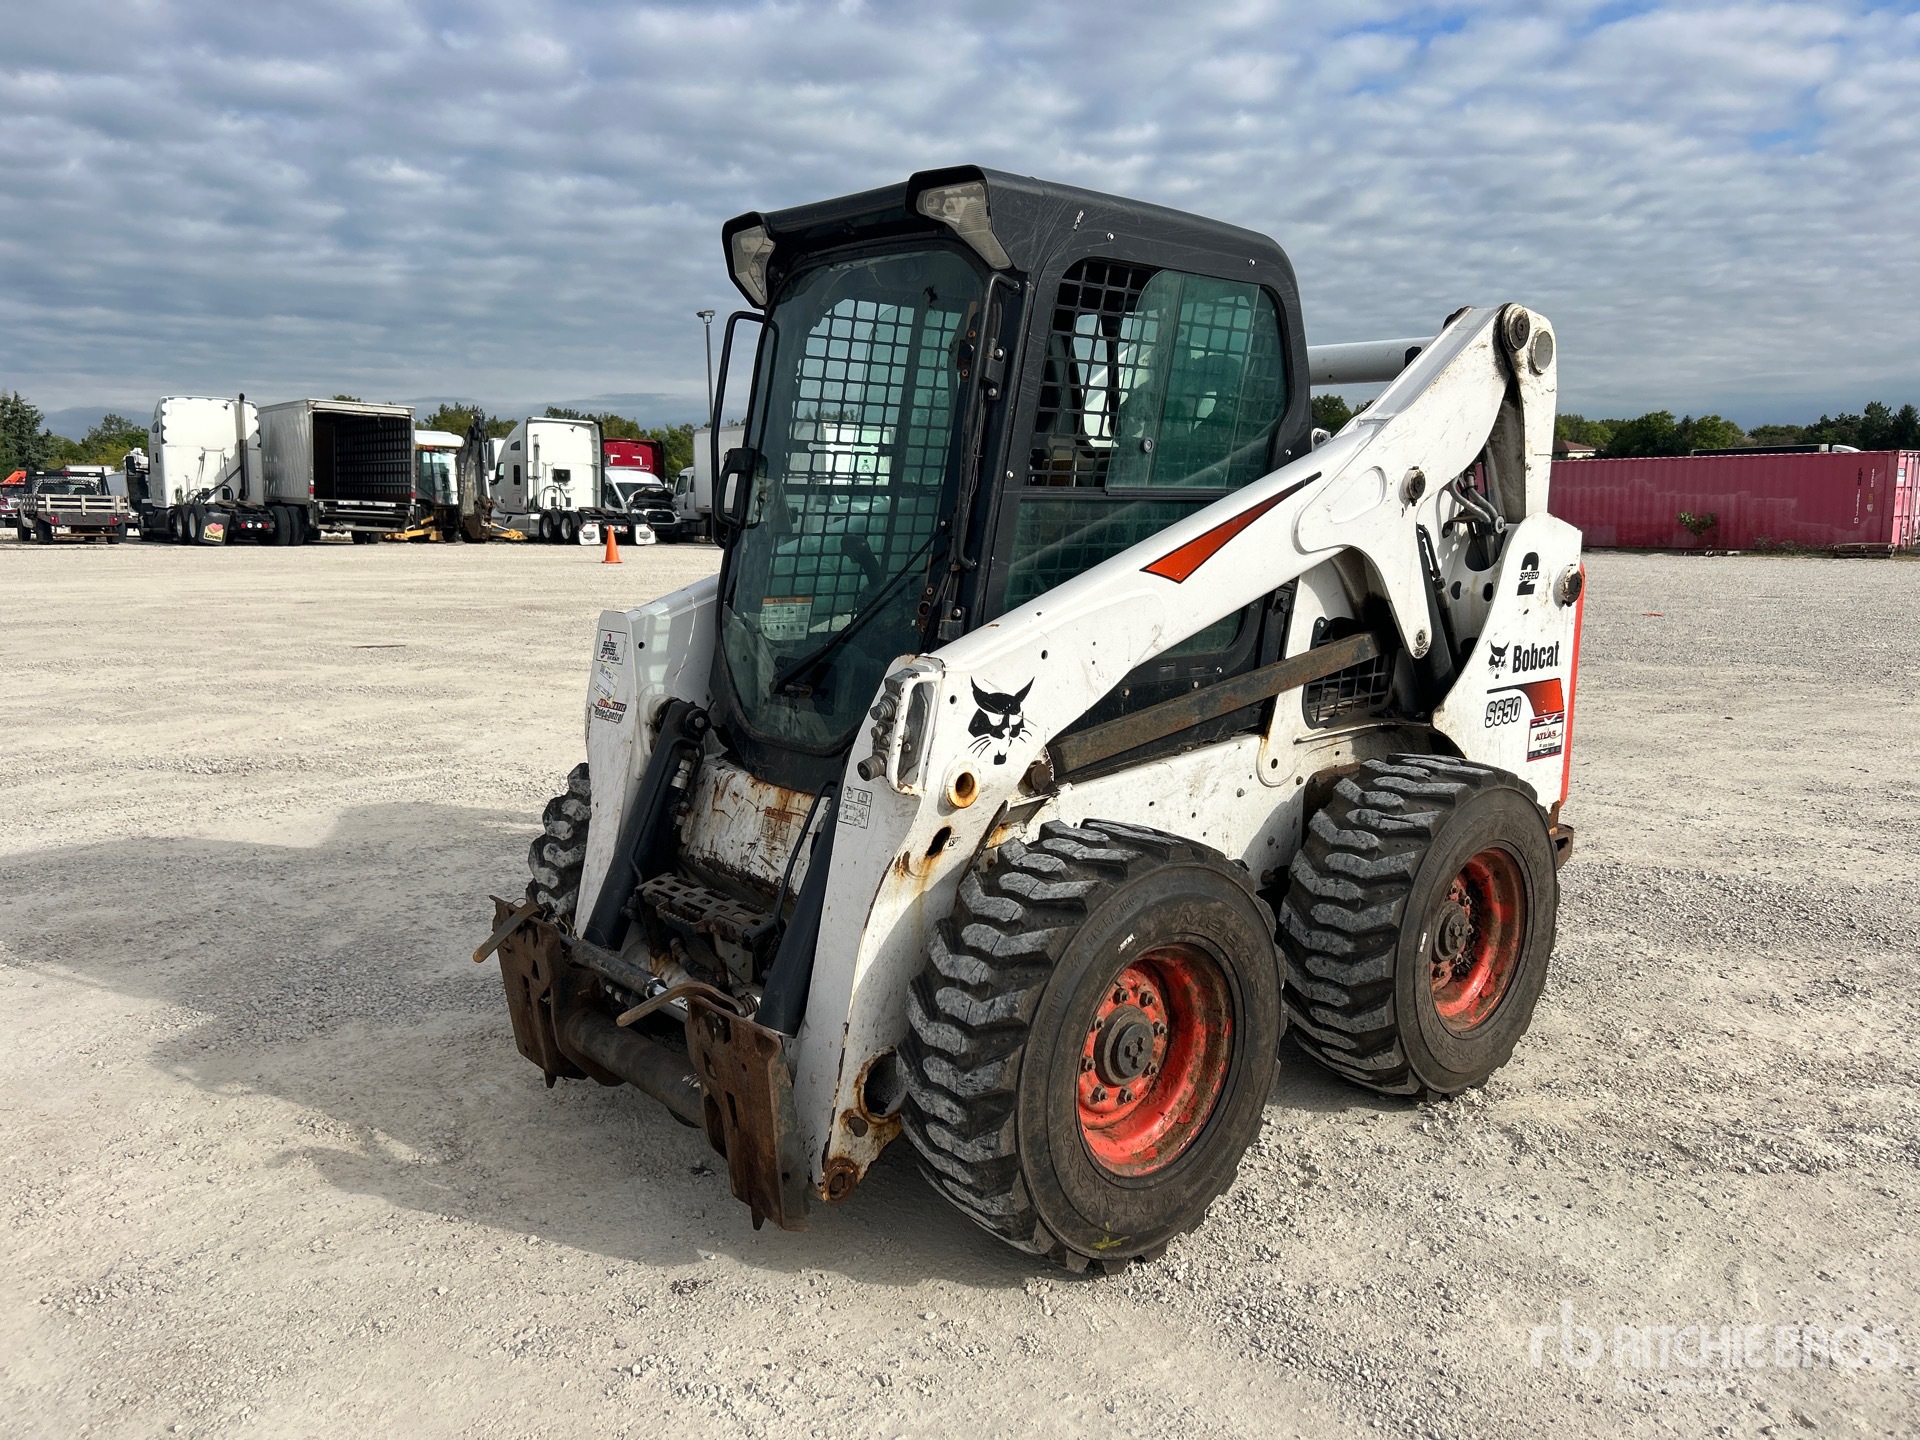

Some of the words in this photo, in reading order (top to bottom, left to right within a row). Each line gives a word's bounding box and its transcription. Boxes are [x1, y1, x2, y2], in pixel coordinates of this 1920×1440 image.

[1517, 552, 1539, 596] 2
[1519, 571, 1540, 581] SPEED
[1512, 641, 1559, 673] Bobcat
[1485, 696, 1521, 728] S650
[1535, 730, 1556, 741] ATLAS
